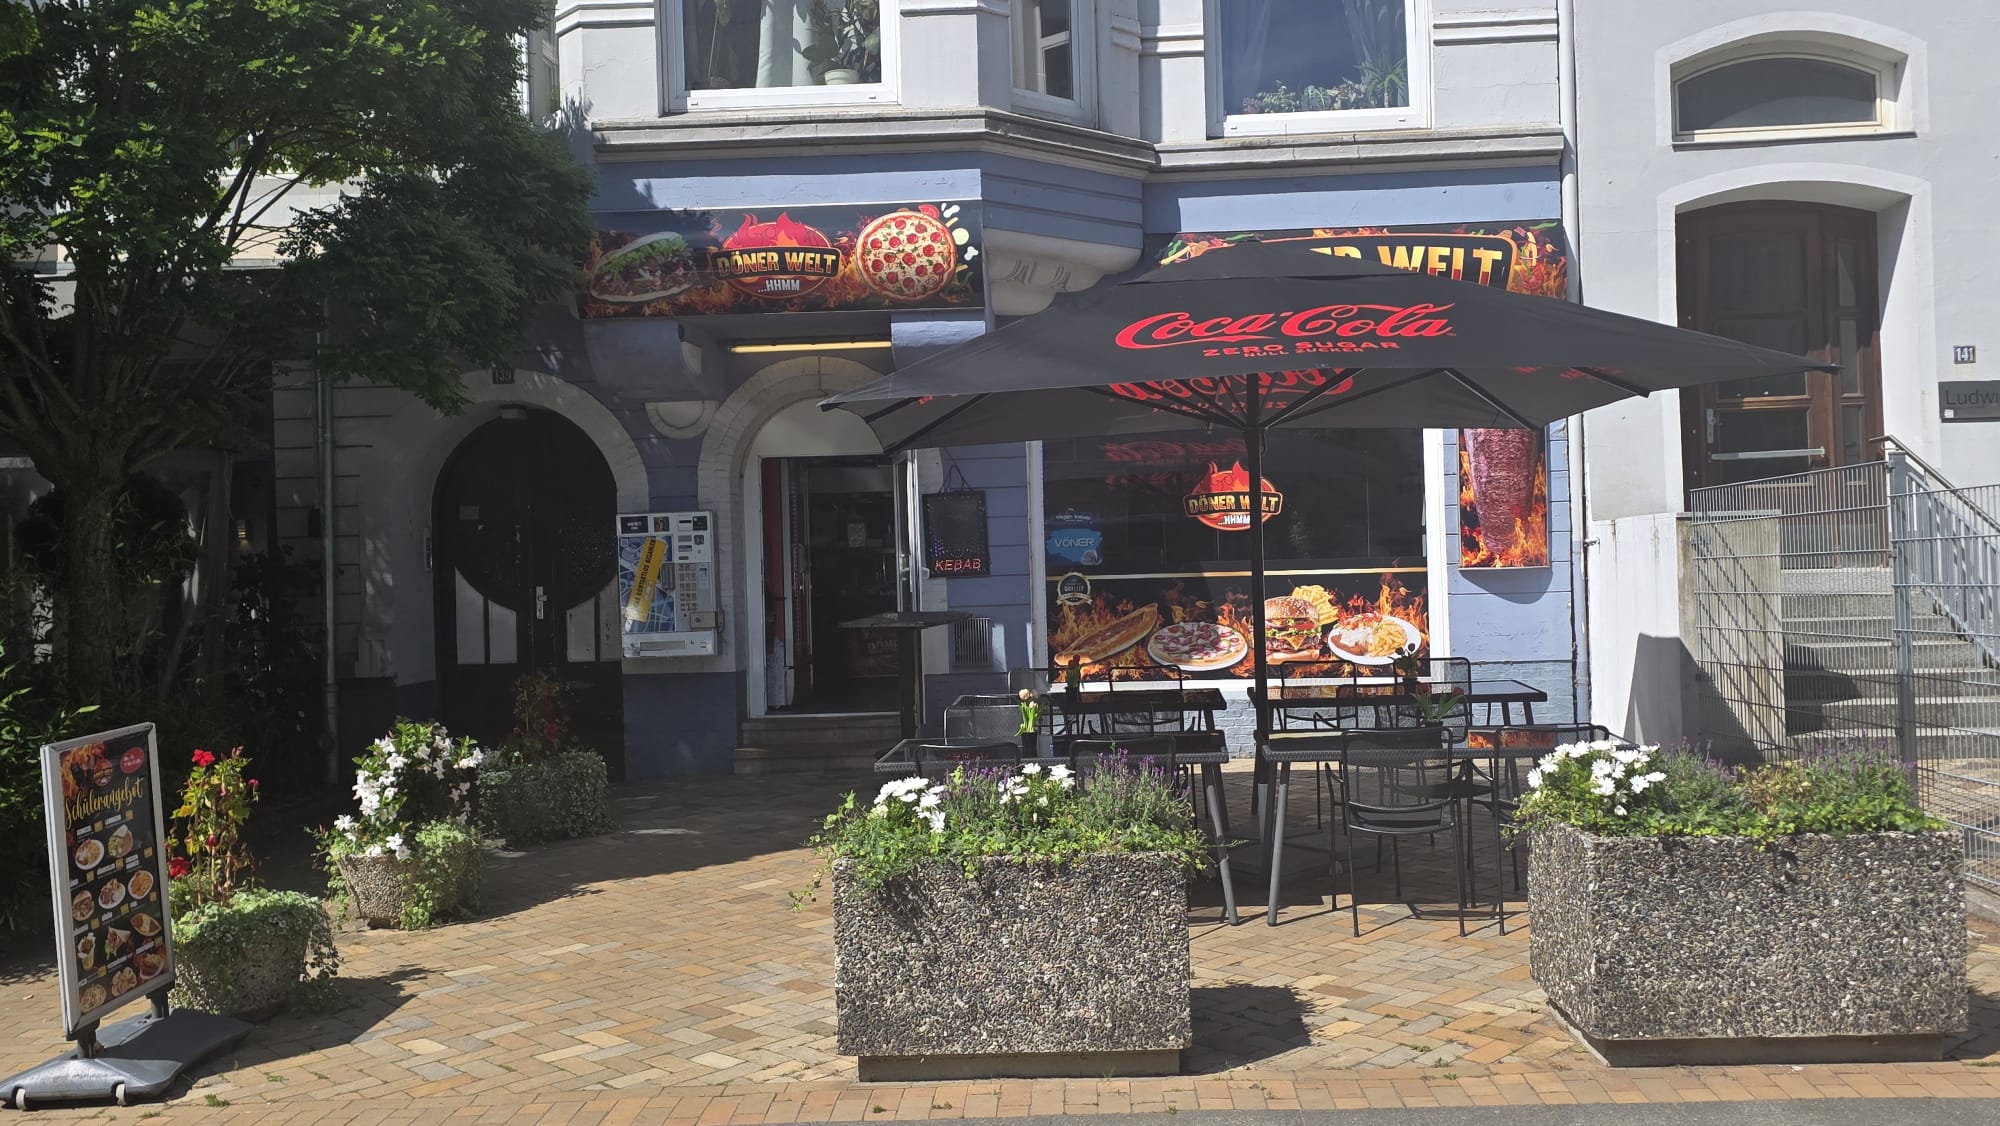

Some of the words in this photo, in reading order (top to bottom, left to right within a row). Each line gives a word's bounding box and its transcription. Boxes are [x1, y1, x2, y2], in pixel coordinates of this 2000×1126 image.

[716, 251, 780, 276] DÖNER
[784, 251, 837, 273] WELT
[1115, 303, 1456, 349] Coca-Cola
[1203, 344, 1284, 357] ZERO
[1295, 341, 1400, 350] SUGAR
[1243, 350, 1289, 358] NULL
[1956, 347, 1974, 361] 141
[1188, 495, 1236, 514] DÖNER
[1239, 495, 1279, 512] WLT
[1054, 536, 1095, 548] VÖNER
[934, 558, 981, 571] KEBAB
[66, 776, 145, 831] Schülerangebot
